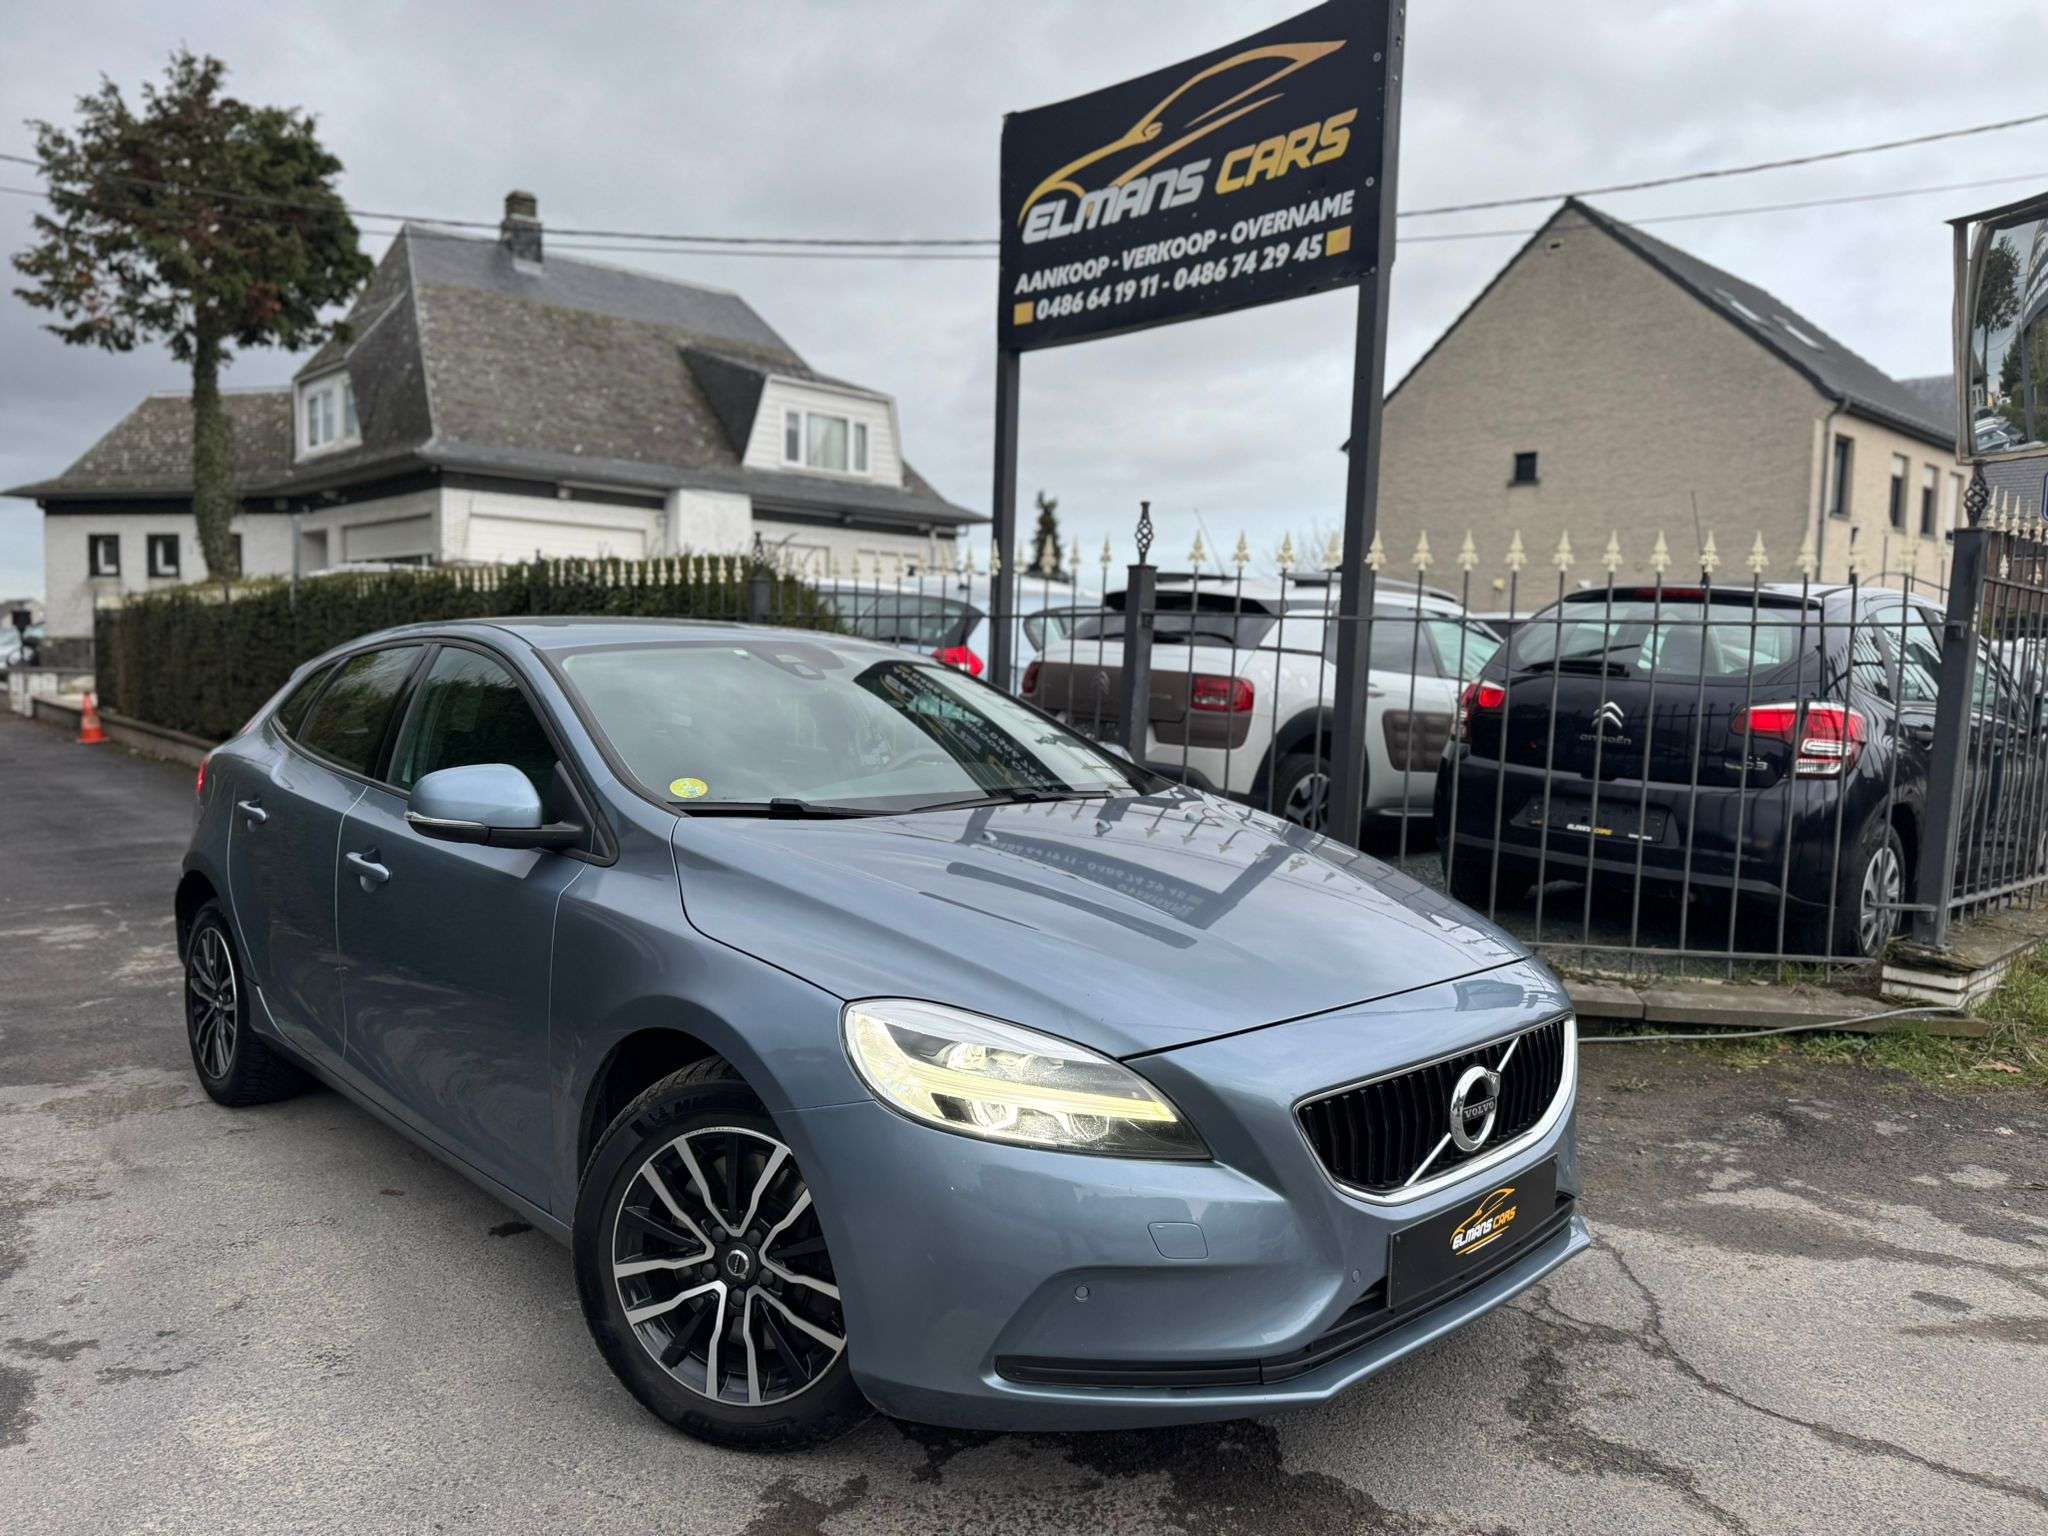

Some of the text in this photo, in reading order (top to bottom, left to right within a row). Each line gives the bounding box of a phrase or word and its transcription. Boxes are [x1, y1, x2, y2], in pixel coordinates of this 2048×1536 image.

[1021, 108, 1358, 244] ELMANS CARS
[1014, 256, 1110, 295] AANKOOP
[1122, 229, 1217, 271] VERKOOP
[1230, 190, 1355, 244] OVERNAME
[1036, 290, 1084, 321] 0486
[1086, 284, 1112, 310] 64
[1115, 279, 1137, 304] 19
[1140, 273, 1160, 299] 11
[1173, 257, 1228, 291] 0486
[1231, 250, 1258, 278] 74
[1259, 242, 1291, 271] 29
[1292, 233, 1323, 262] 45
[1464, 1100, 1495, 1119] VOLVO
[1452, 1205, 1517, 1250] ELMANS CARS
